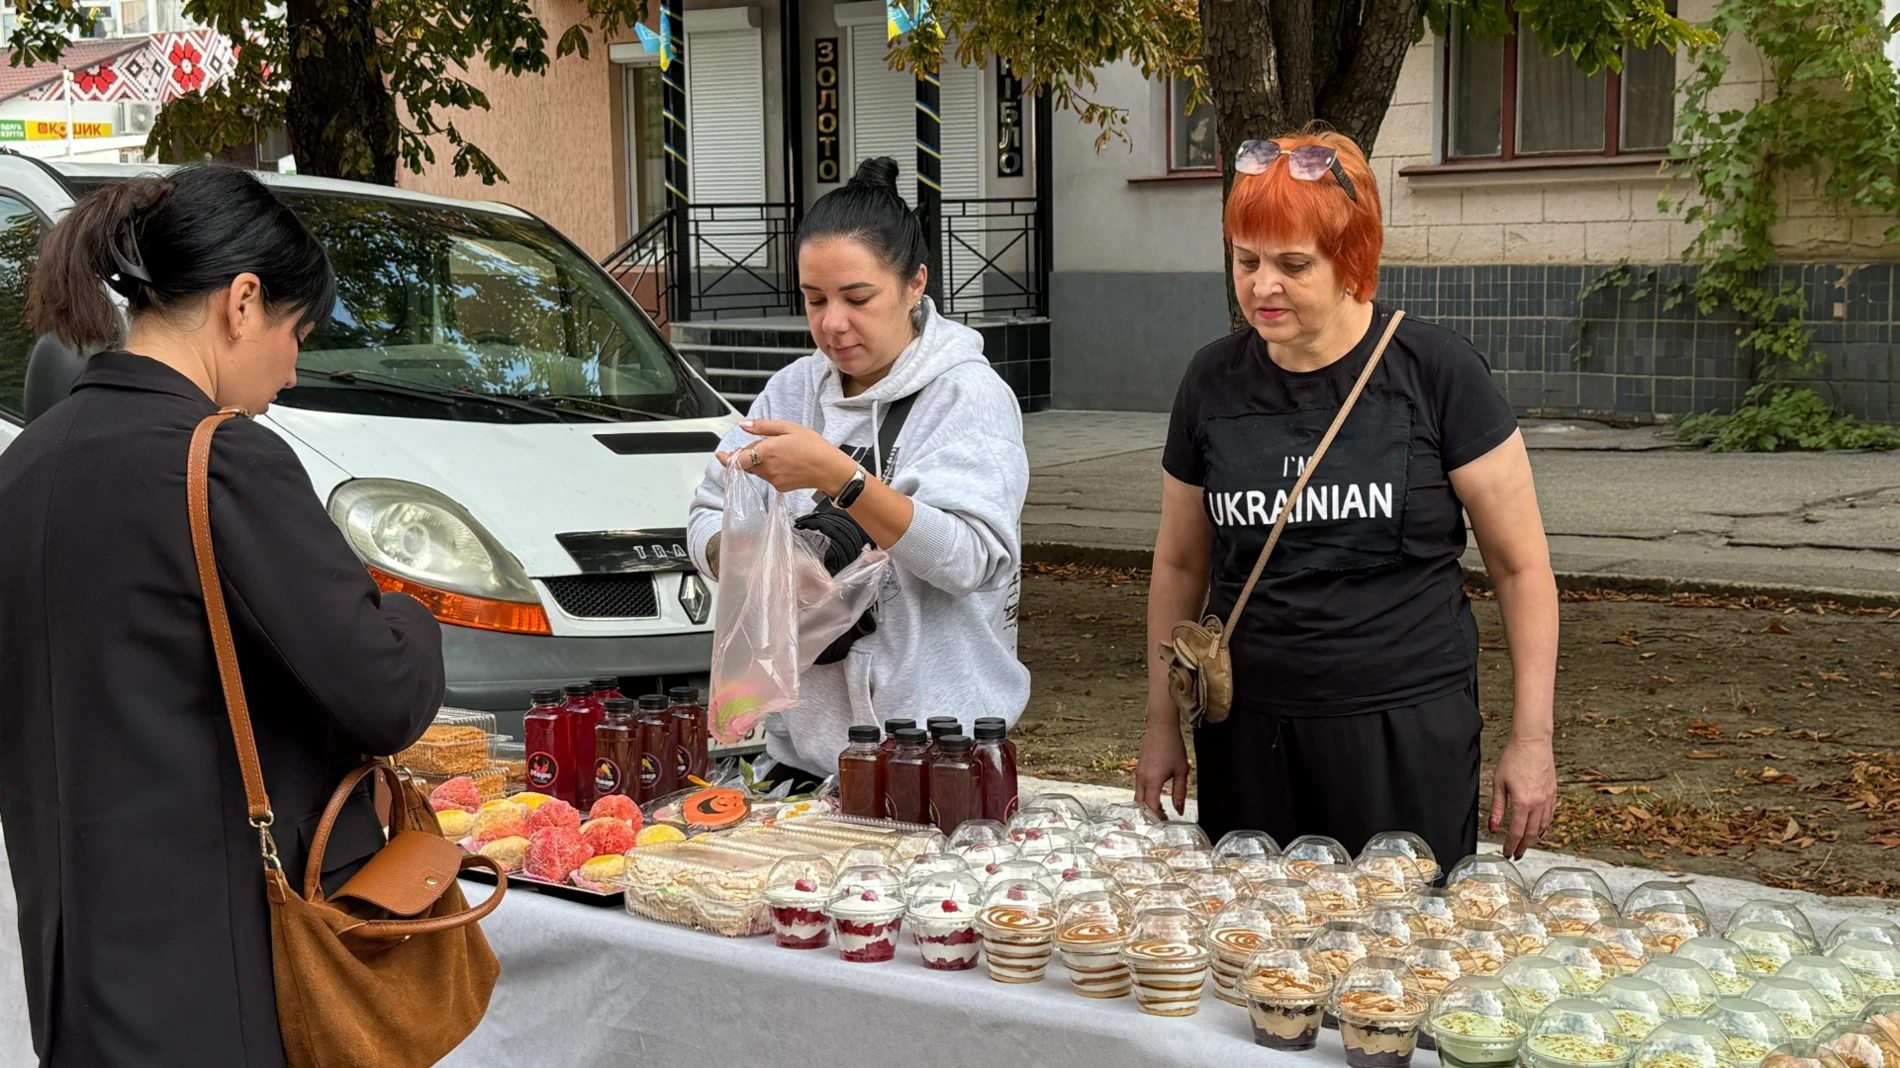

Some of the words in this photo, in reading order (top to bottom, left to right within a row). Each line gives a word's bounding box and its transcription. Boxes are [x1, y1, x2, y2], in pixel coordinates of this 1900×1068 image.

[817, 41, 838, 180] ЗОЛОТО
[50, 122, 101, 138] КОШИК
[1208, 482, 1393, 526] UKRAINIAN
[633, 544, 687, 559] TRA
